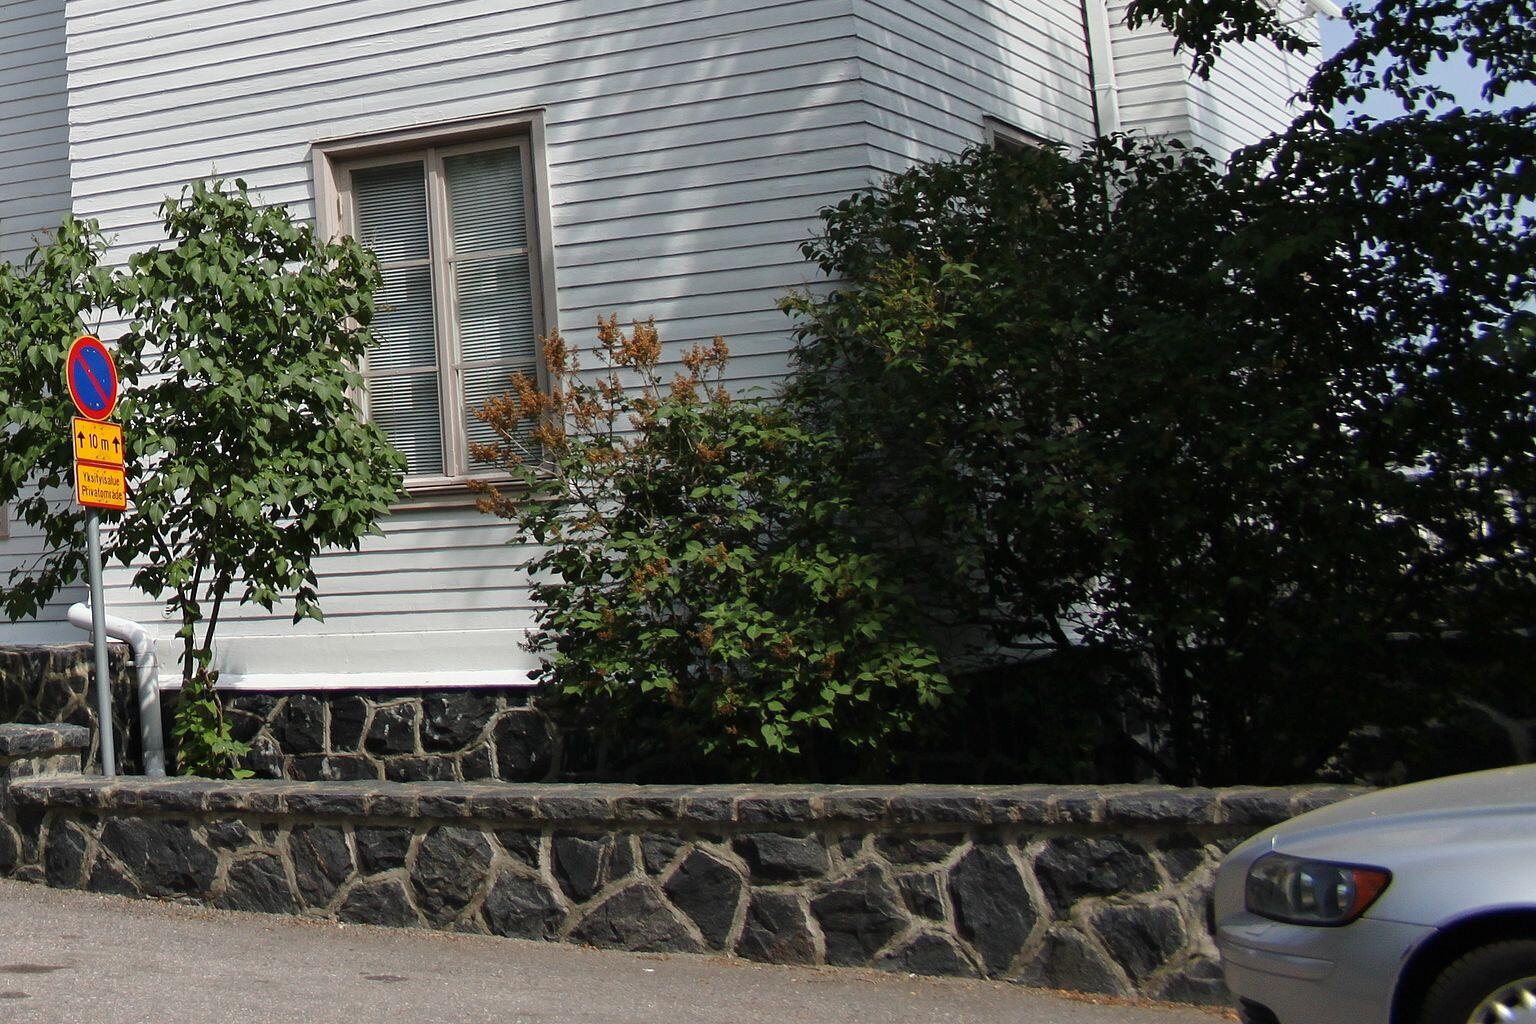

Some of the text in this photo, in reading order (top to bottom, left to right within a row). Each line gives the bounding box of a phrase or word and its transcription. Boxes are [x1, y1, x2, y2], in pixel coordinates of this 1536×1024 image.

[89, 433, 109, 450] 10 m
[83, 472, 120, 486] Yksityisalue
